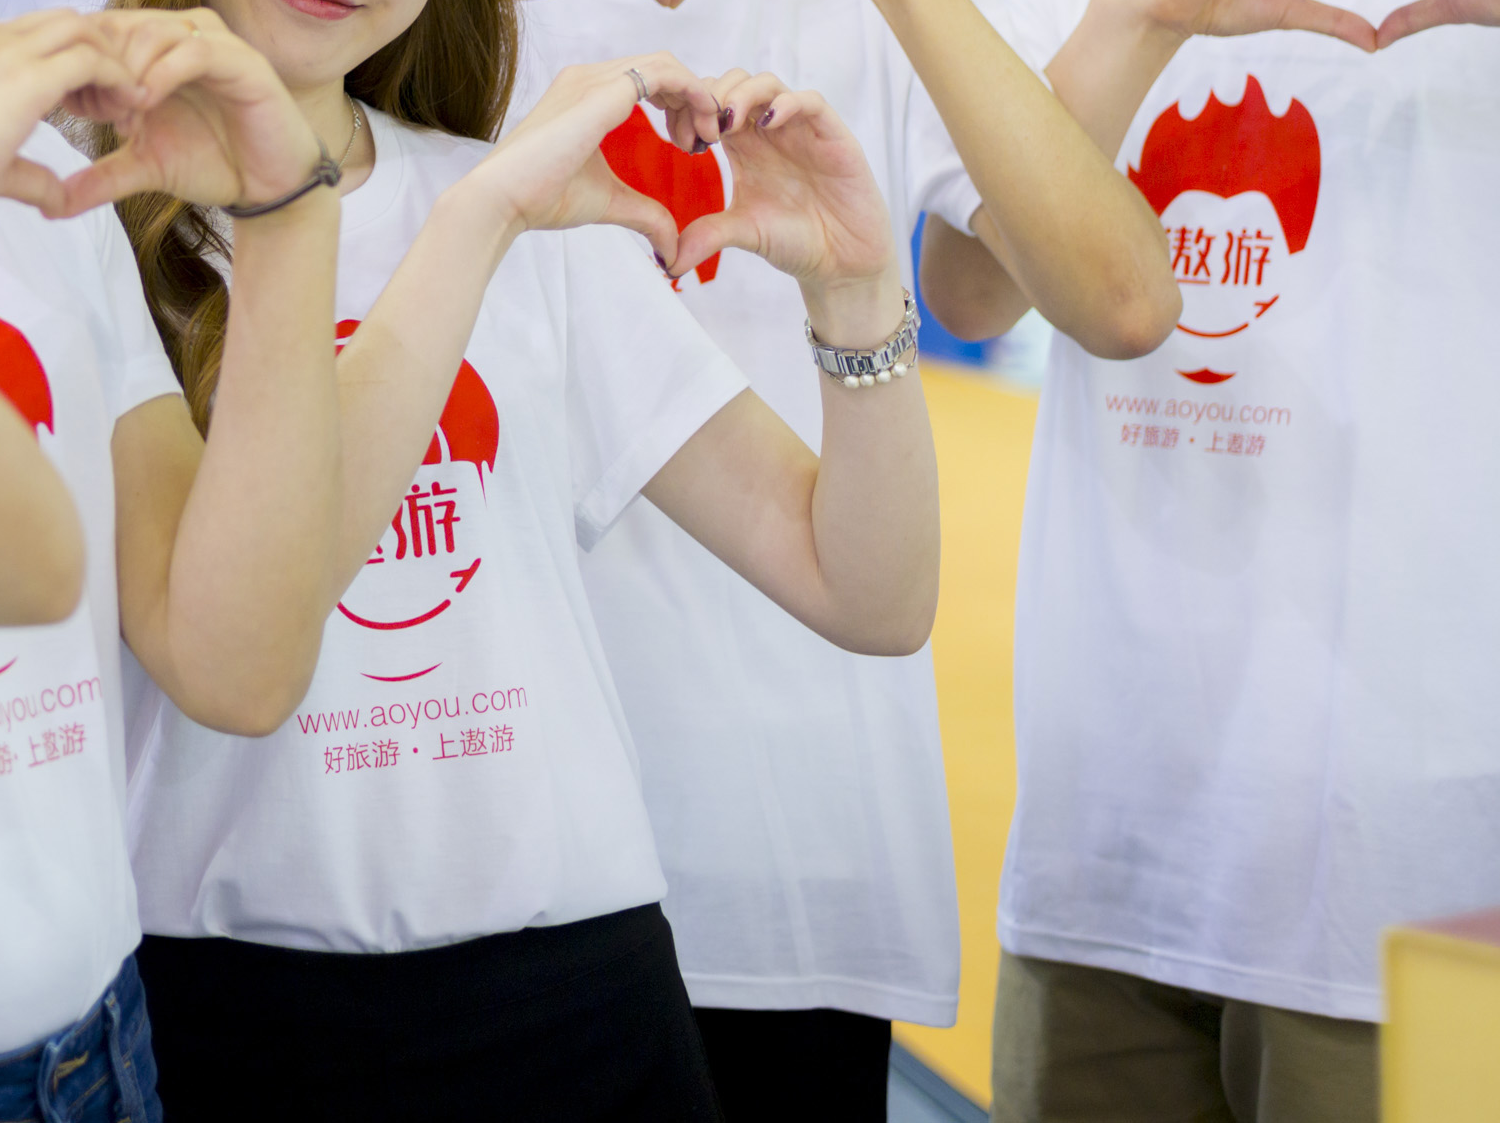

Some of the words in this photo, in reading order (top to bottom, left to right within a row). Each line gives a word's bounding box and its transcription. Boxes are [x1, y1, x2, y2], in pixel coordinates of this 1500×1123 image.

[1166, 225, 1275, 286] 遨游
[1105, 393, 1292, 426] www.aoyou.com
[297, 686, 528, 735] www.aoyou.com
[323, 723, 516, 775] 好旅游·上遨游
